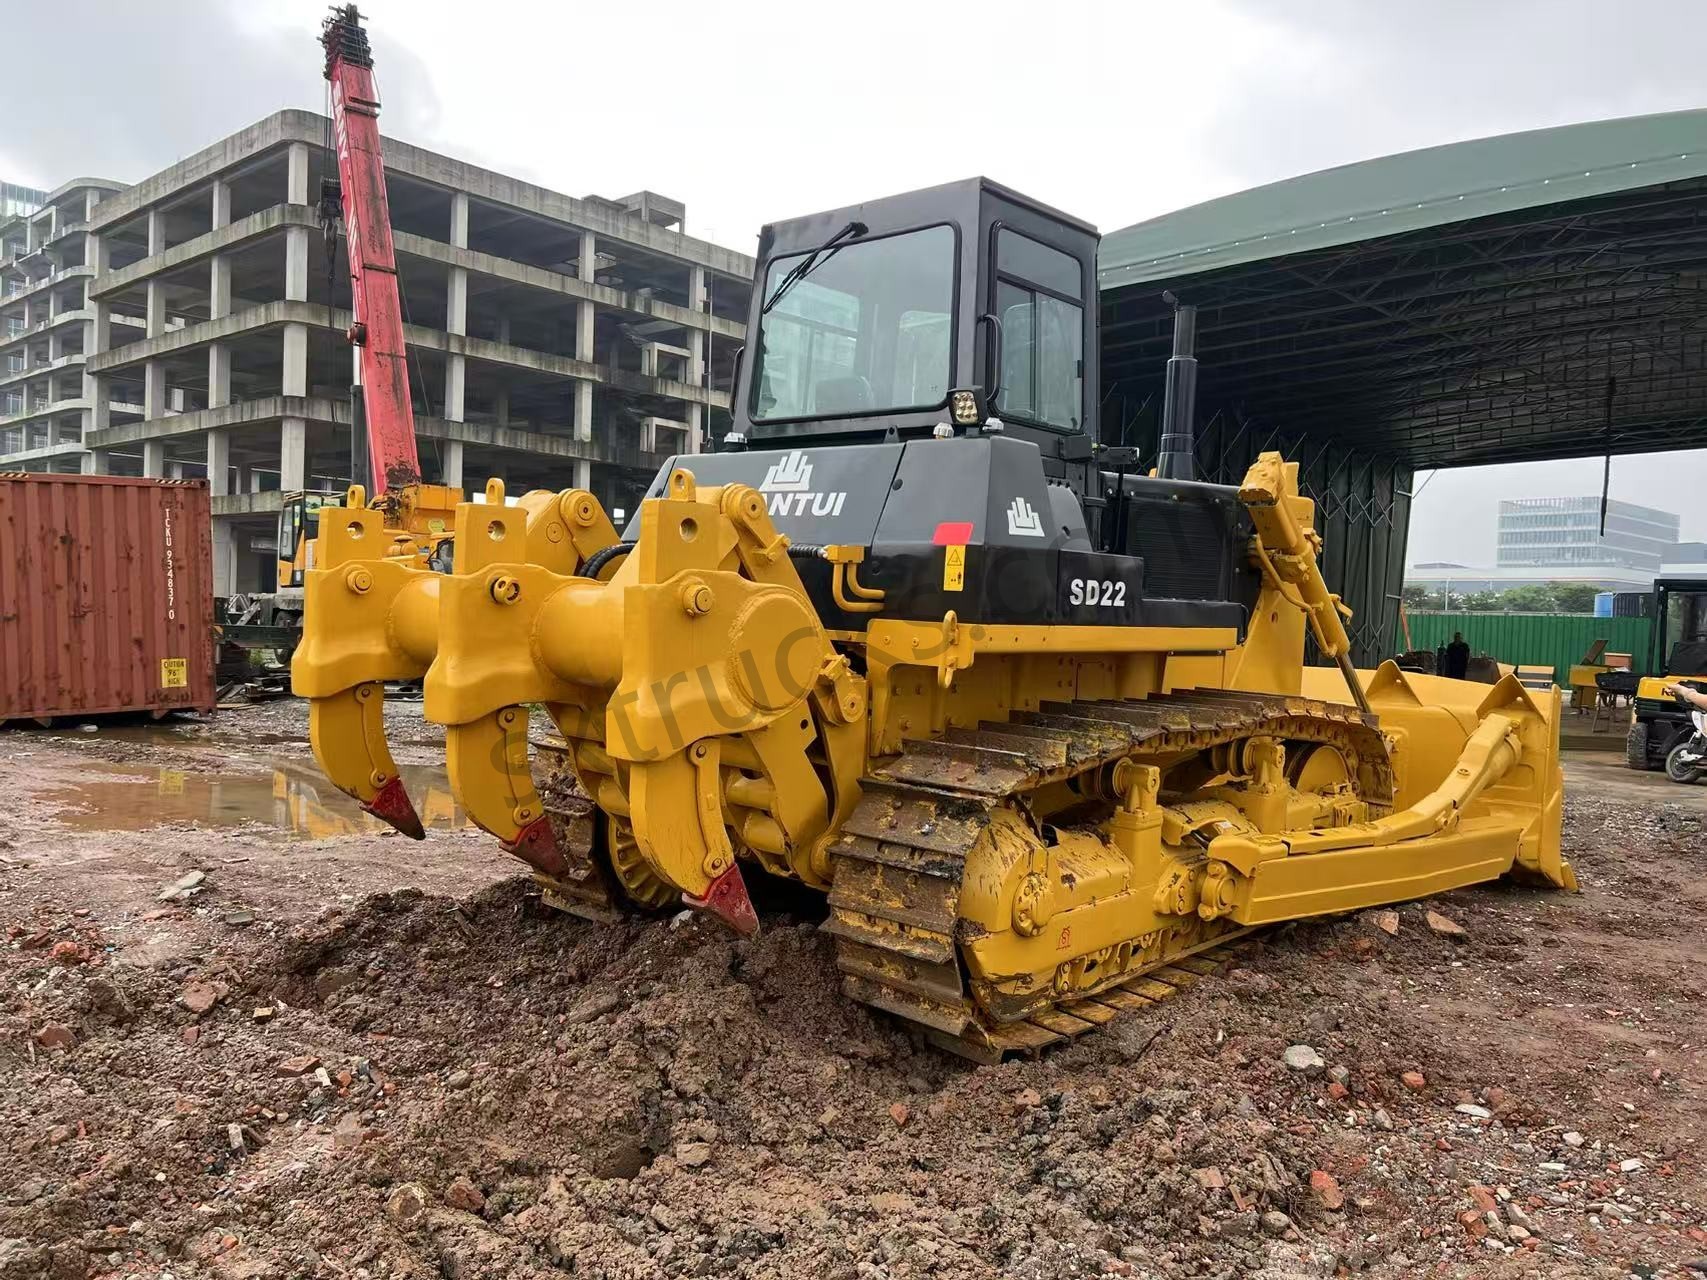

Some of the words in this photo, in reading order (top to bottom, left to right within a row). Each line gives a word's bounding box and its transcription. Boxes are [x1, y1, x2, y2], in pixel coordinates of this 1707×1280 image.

[166, 550, 174, 606] 934837
[1069, 578, 1126, 607] SD22
[168, 609, 175, 620] 0
